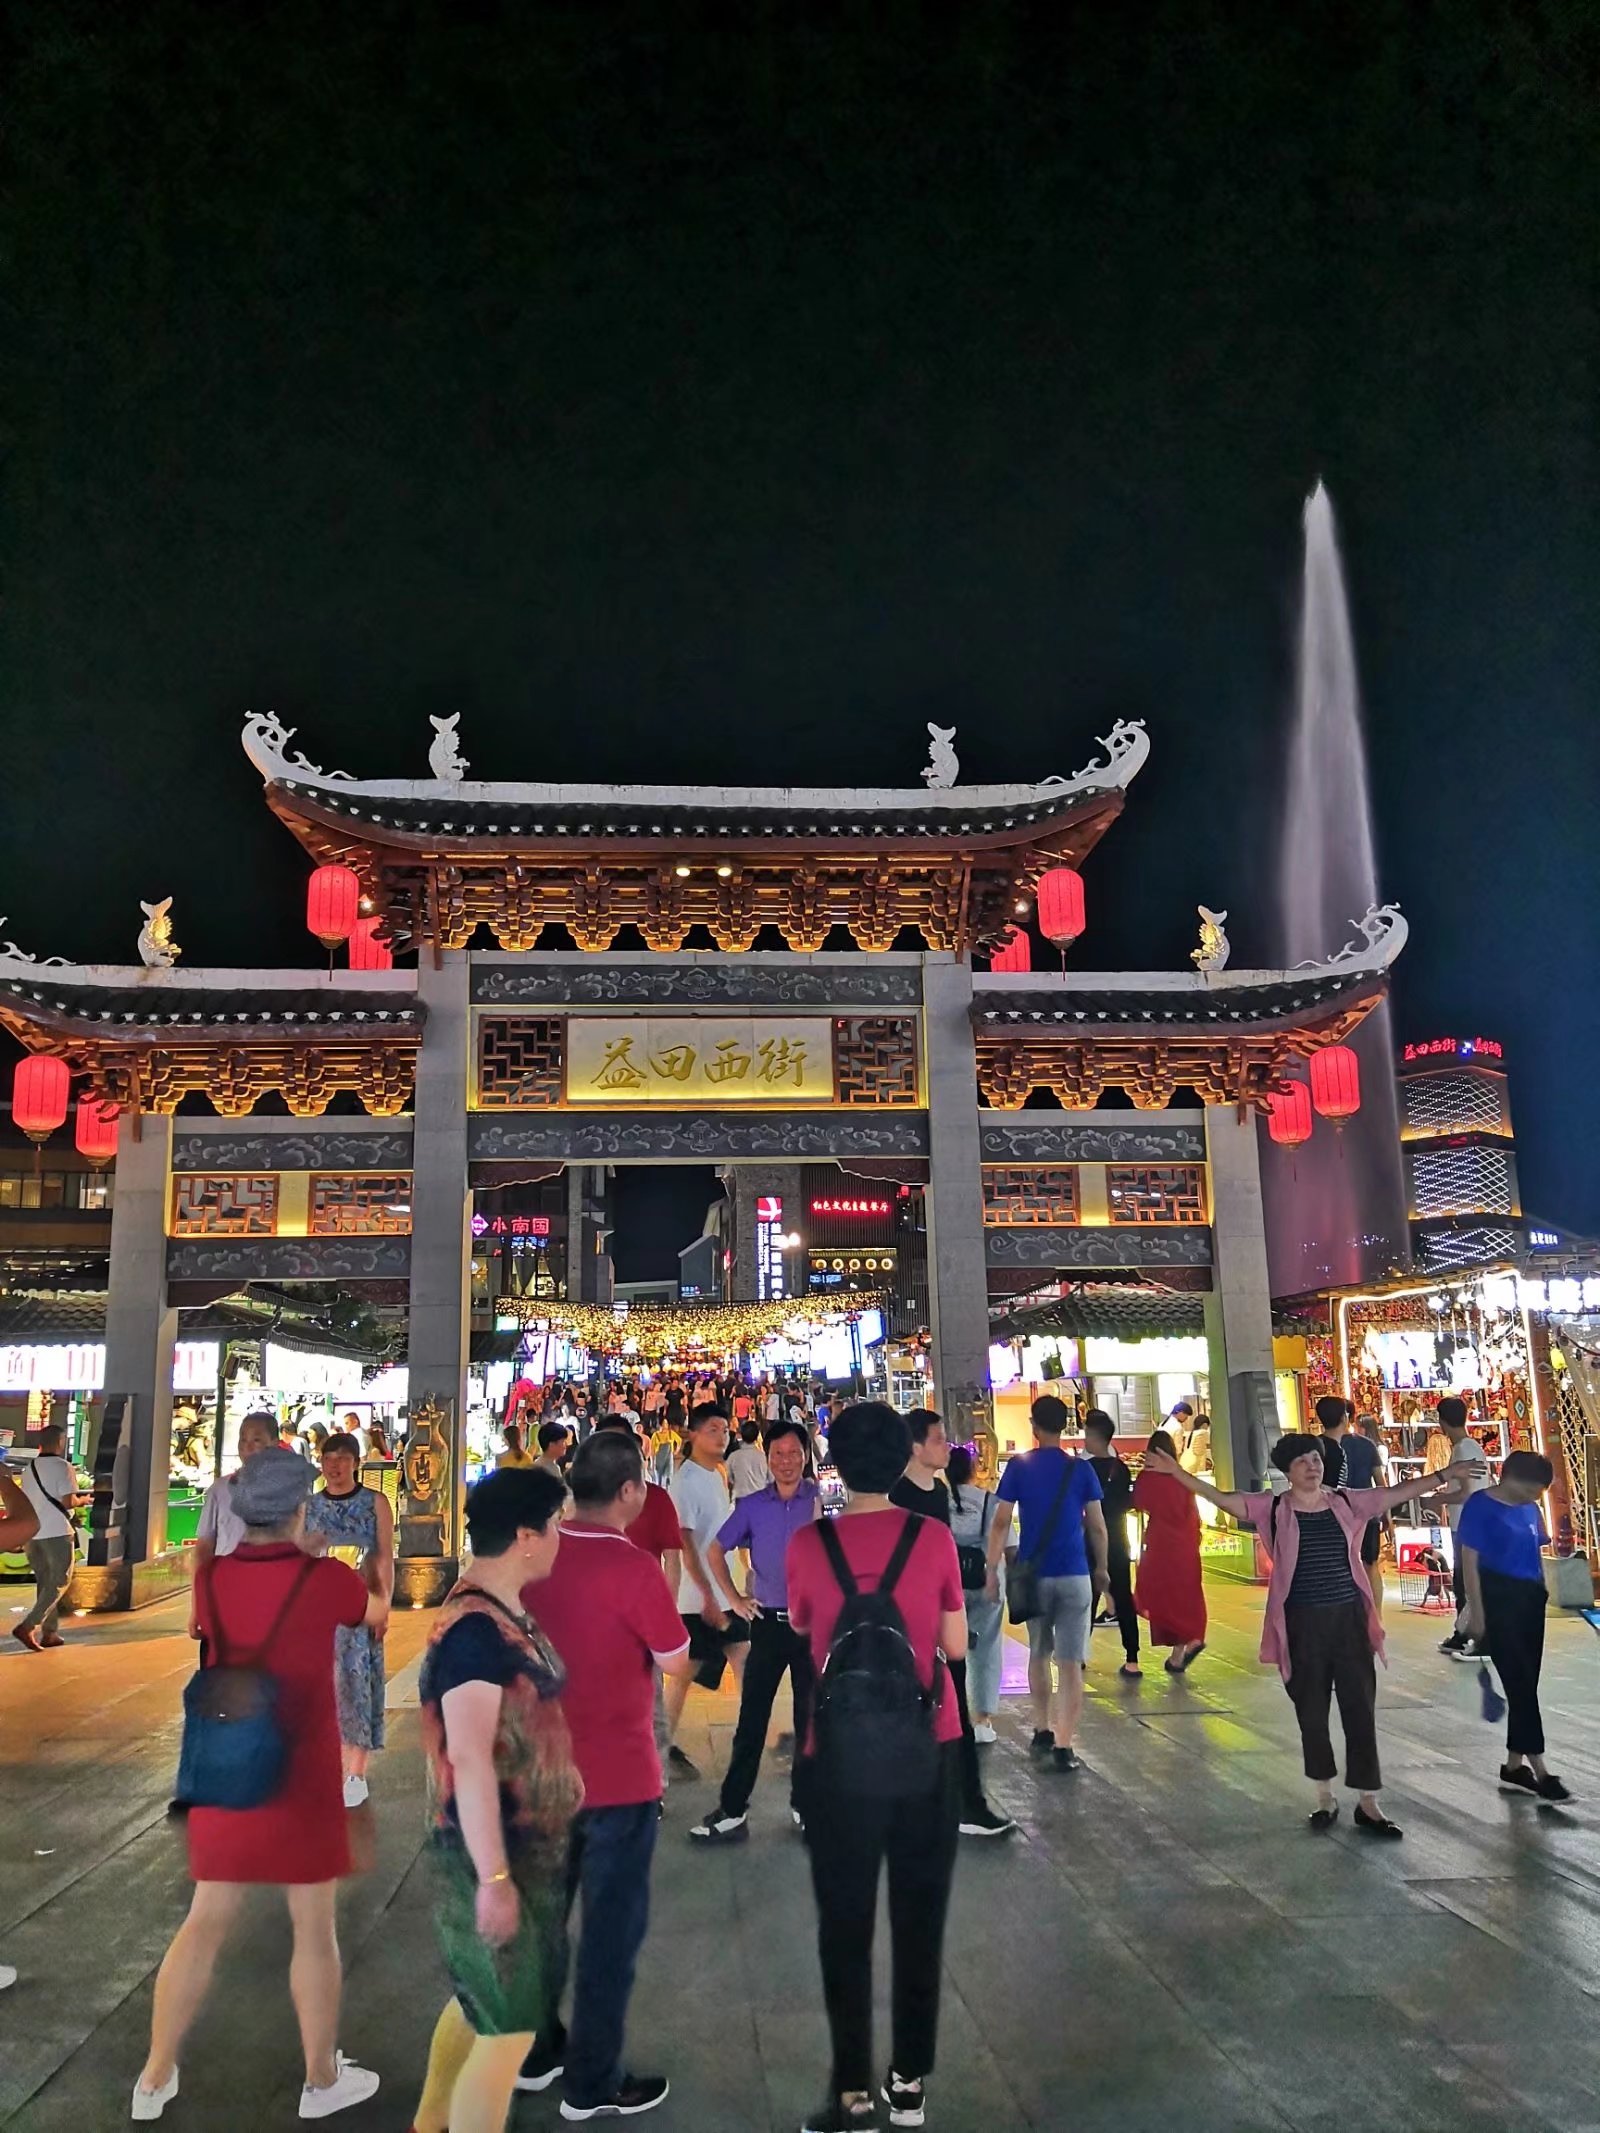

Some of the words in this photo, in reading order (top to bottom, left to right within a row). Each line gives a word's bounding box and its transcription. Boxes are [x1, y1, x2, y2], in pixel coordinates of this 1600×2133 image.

[590, 1037, 807, 1090] 益田西街
[491, 1216, 550, 1234] 小南国
